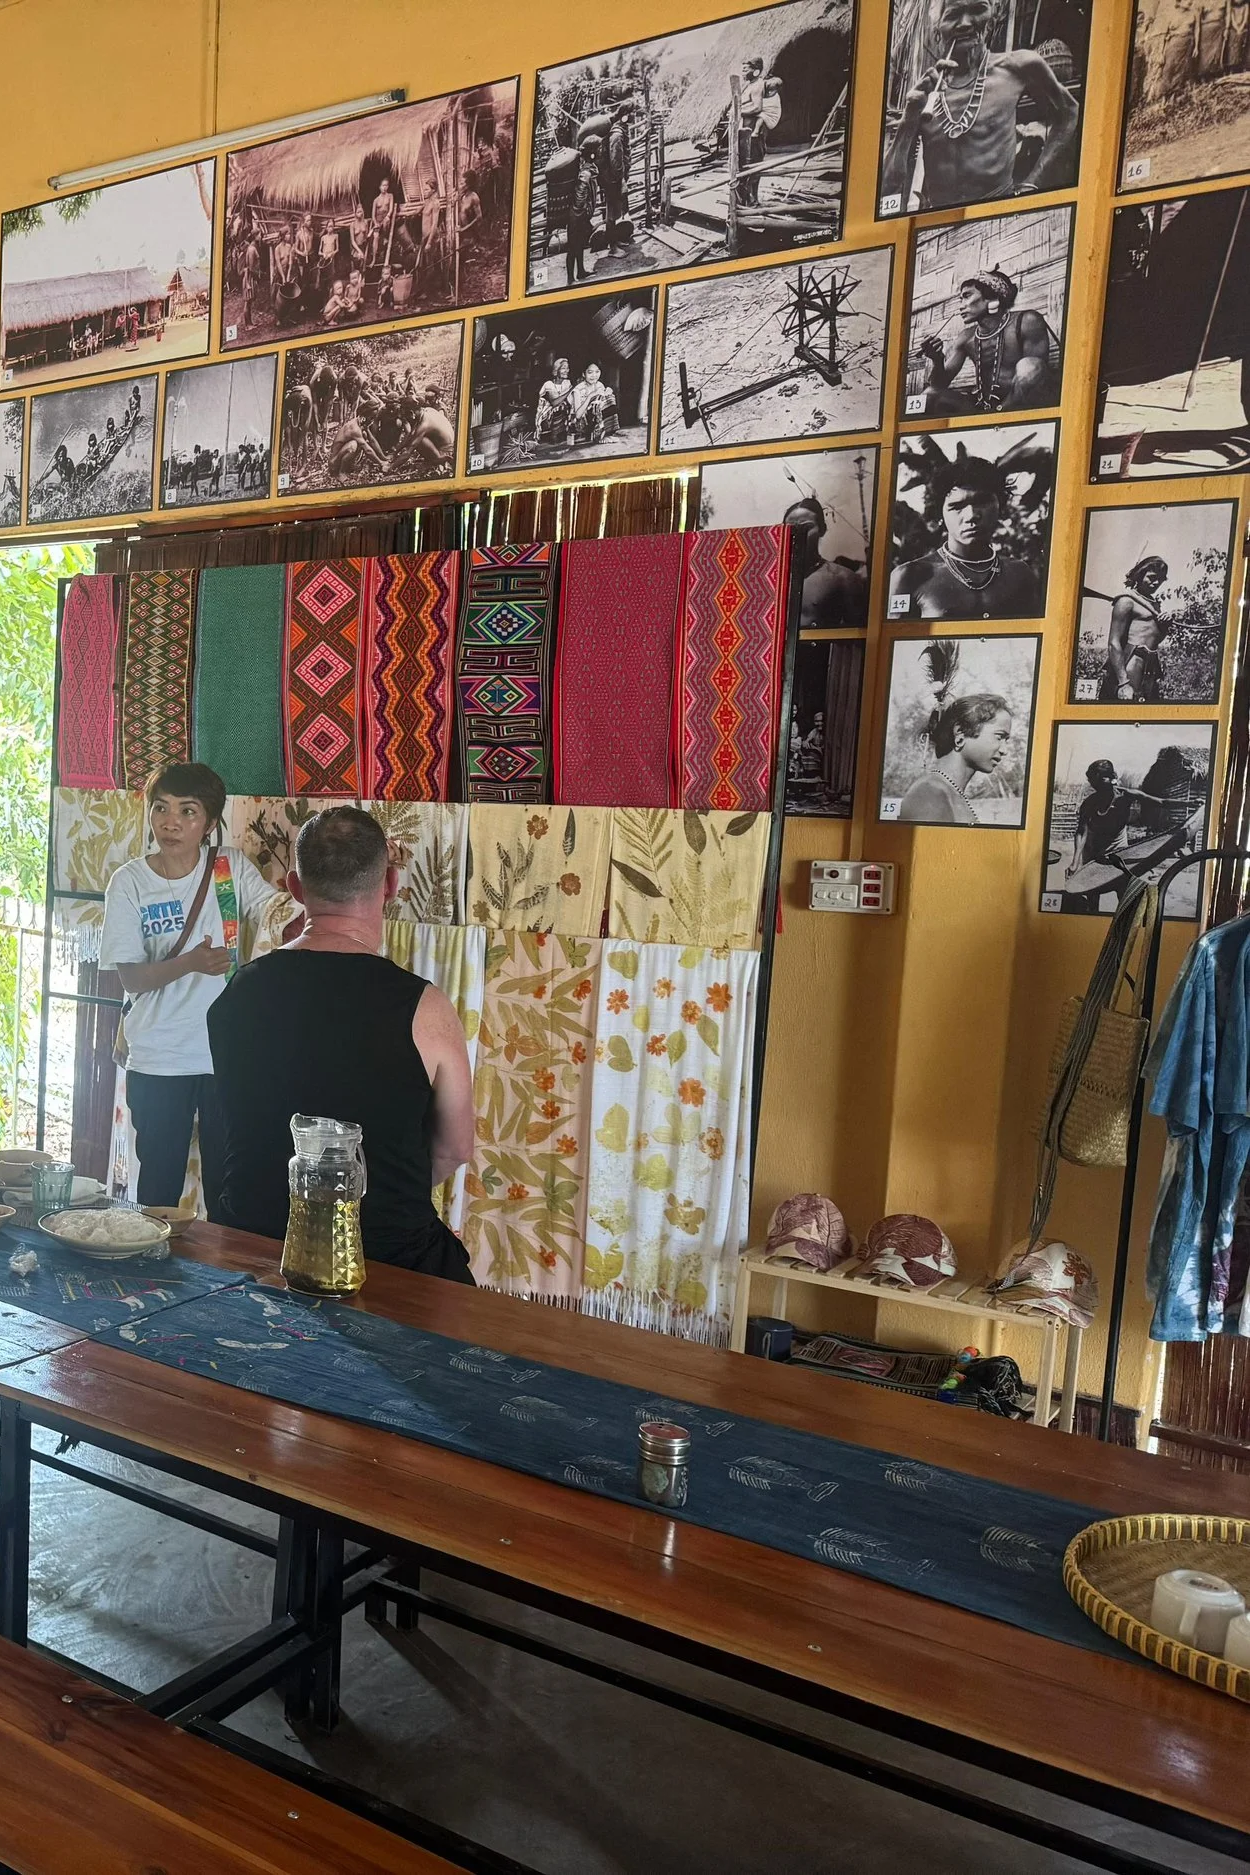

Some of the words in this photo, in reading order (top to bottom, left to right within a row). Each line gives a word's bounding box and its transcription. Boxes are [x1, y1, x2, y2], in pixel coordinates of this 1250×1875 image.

[1128, 164, 1142, 177] 16
[884, 200, 898, 210] 12
[908, 400, 921, 410] 13
[664, 438, 674, 446] 11
[472, 458, 482, 467] 10
[1102, 460, 1114, 469] 21
[280, 477, 285, 485] 9
[892, 600, 906, 609] 14
[1080, 685, 1094, 694] 27
[883, 802, 896, 812] 15
[1045, 898, 1056, 907] 28
[142, 917, 185, 939] 2025
